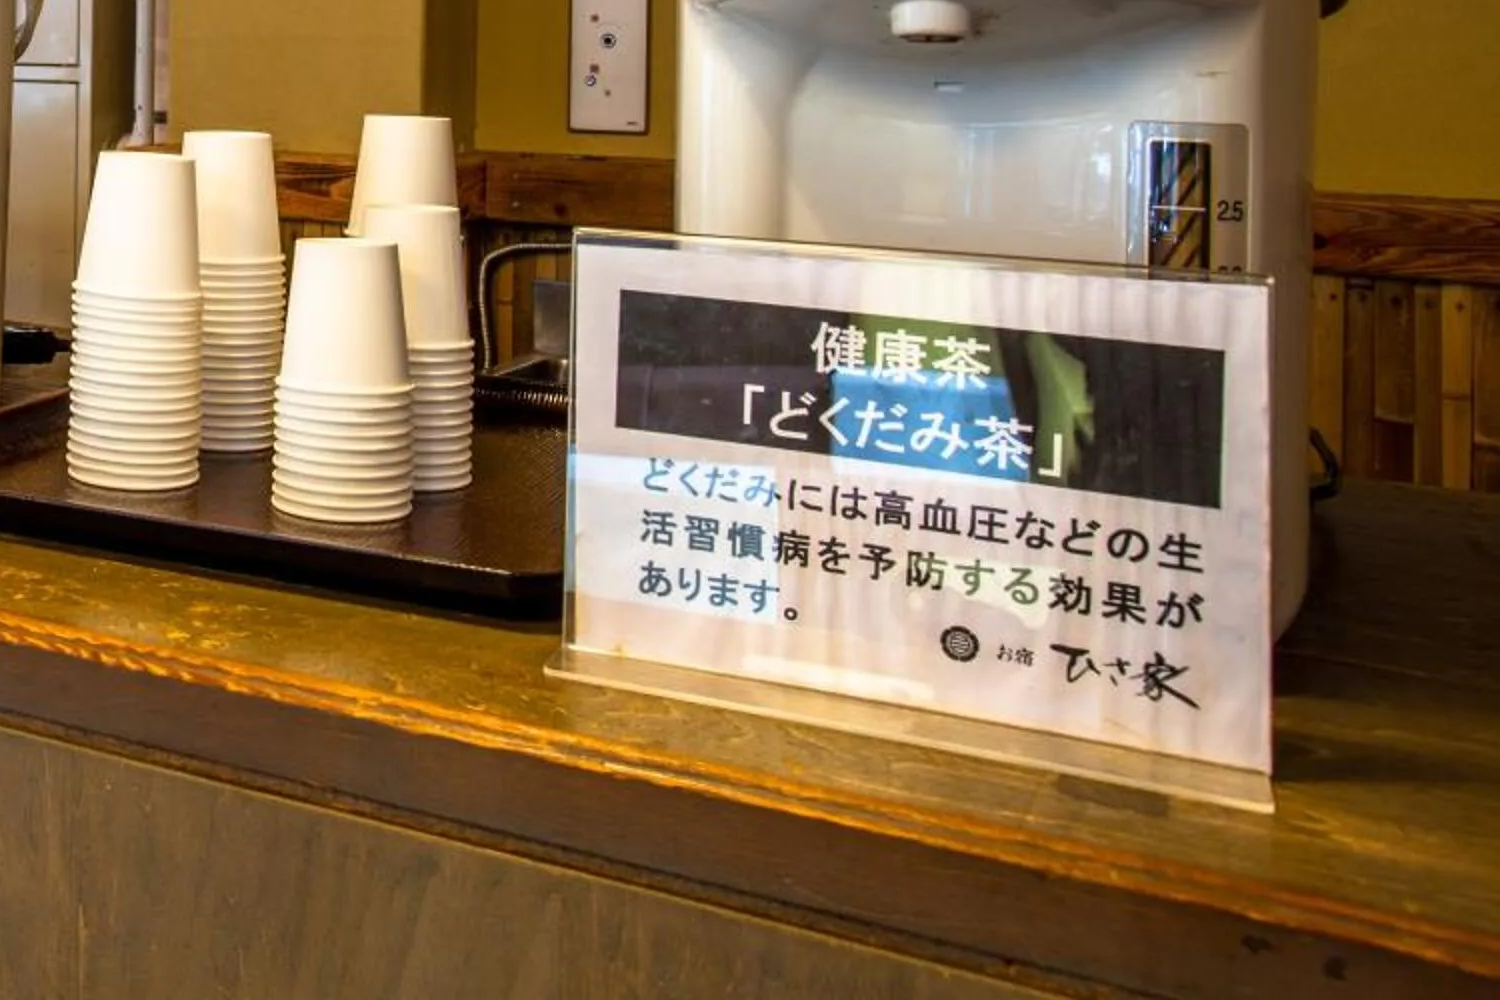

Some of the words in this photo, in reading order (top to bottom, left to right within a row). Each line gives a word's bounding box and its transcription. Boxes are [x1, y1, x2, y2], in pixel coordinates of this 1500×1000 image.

[810, 322, 992, 390] 健康茶
[742, 385, 1064, 479] 「どくだみ茶」
[642, 456, 1205, 573] どくだみには高血圧などの生
[638, 560, 801, 623] あります。
[639, 508, 1205, 629] 活習慣病を予防する効果が
